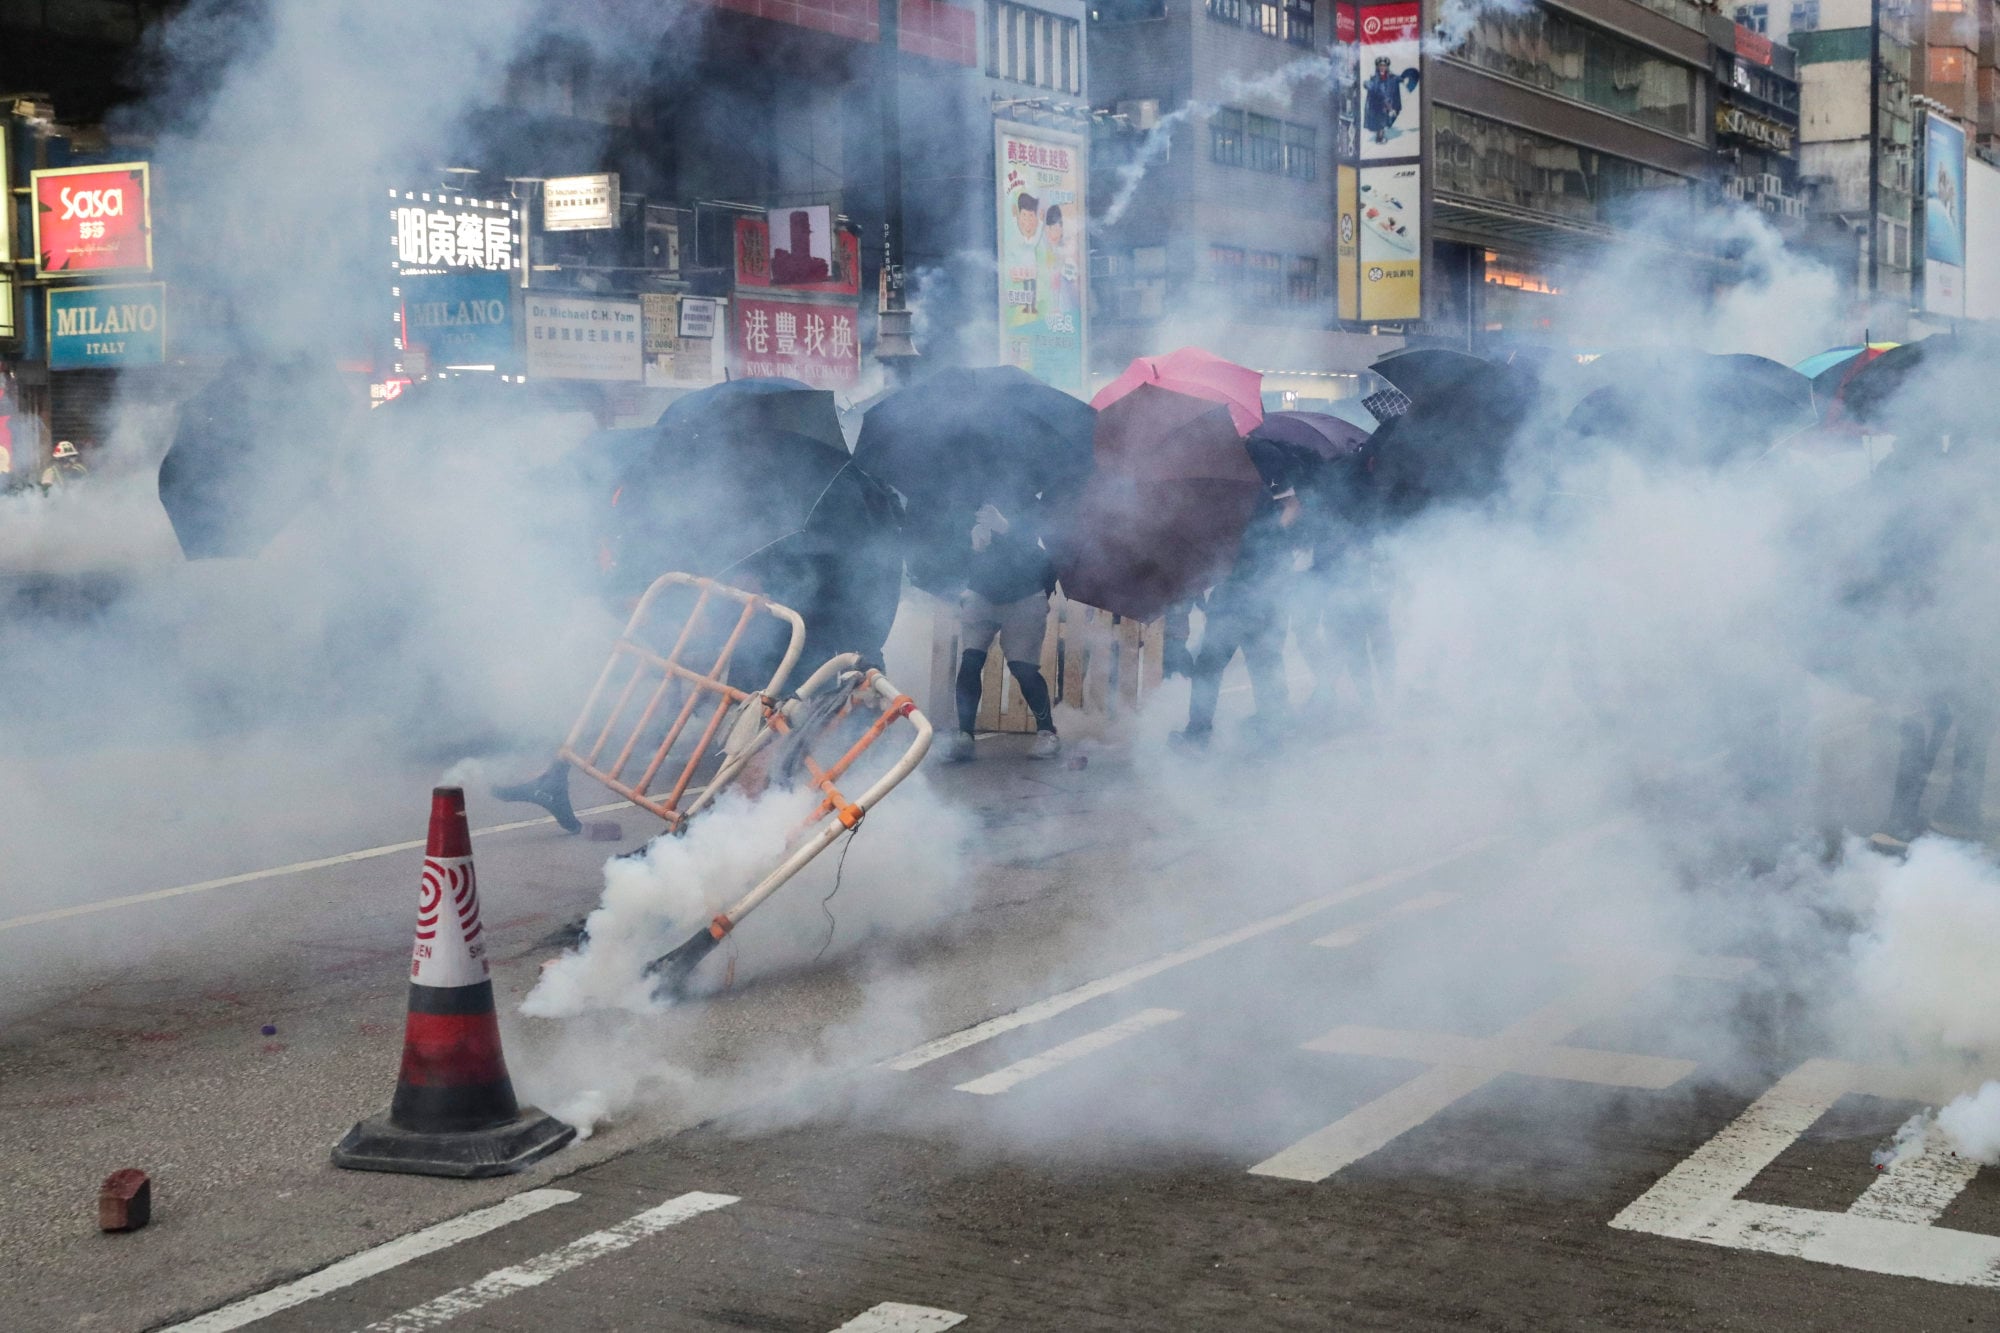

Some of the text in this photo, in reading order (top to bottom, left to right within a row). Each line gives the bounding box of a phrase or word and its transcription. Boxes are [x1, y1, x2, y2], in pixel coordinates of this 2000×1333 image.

[397, 207, 512, 270] 明寅藥房
[56, 303, 158, 337] MILANO
[413, 299, 505, 327] MILANO
[549, 306, 589, 320] Michael
[614, 311, 634, 323] Yam
[86, 342, 125, 355] ITALY
